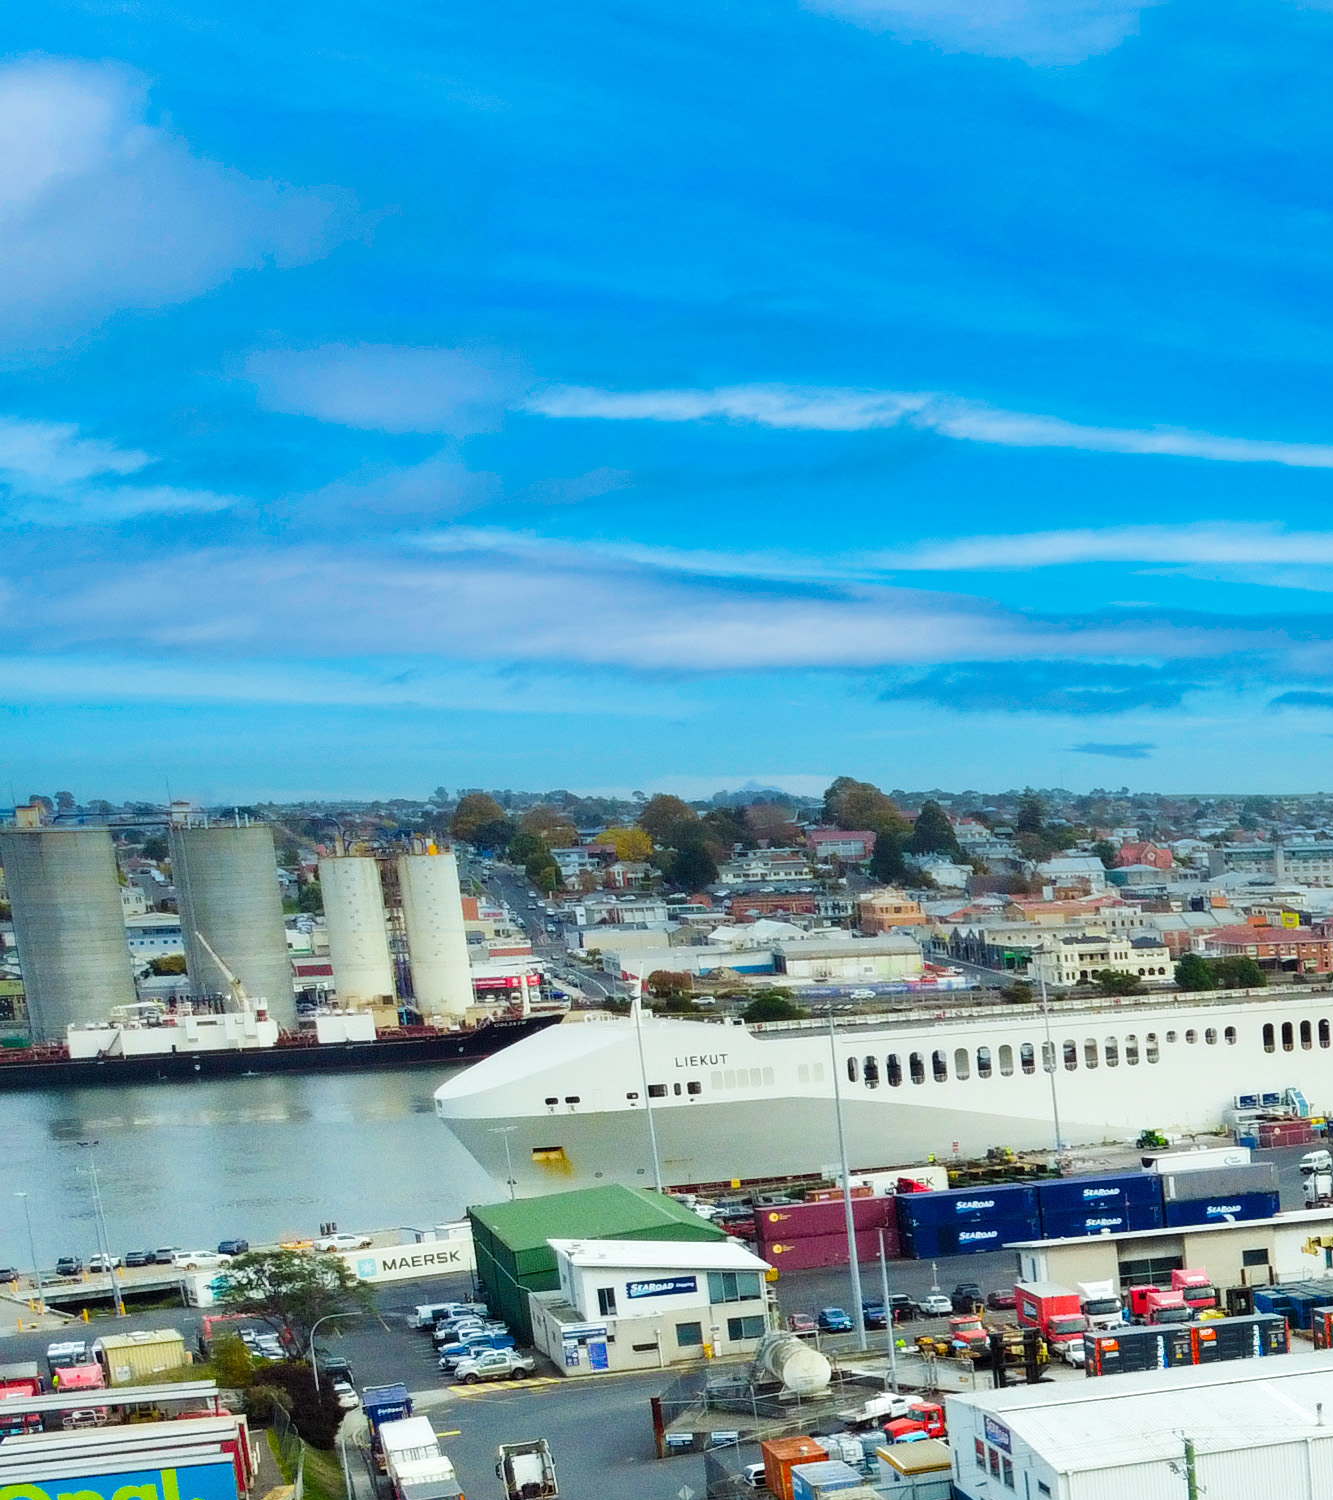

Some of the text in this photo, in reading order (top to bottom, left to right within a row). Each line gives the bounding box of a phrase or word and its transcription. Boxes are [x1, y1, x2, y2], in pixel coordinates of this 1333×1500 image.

[675, 1053, 728, 1068] LIEKUT
[1083, 1188, 1120, 1197] SEAROAD
[956, 1200, 995, 1210] SEAROAD
[1207, 1205, 1241, 1214] SEAROAD
[1085, 1217, 1122, 1226] SEAROAD
[959, 1230, 998, 1240] SEAROAD
[382, 1250, 461, 1272] MAERSK
[630, 1282, 674, 1292] SEAROAD
